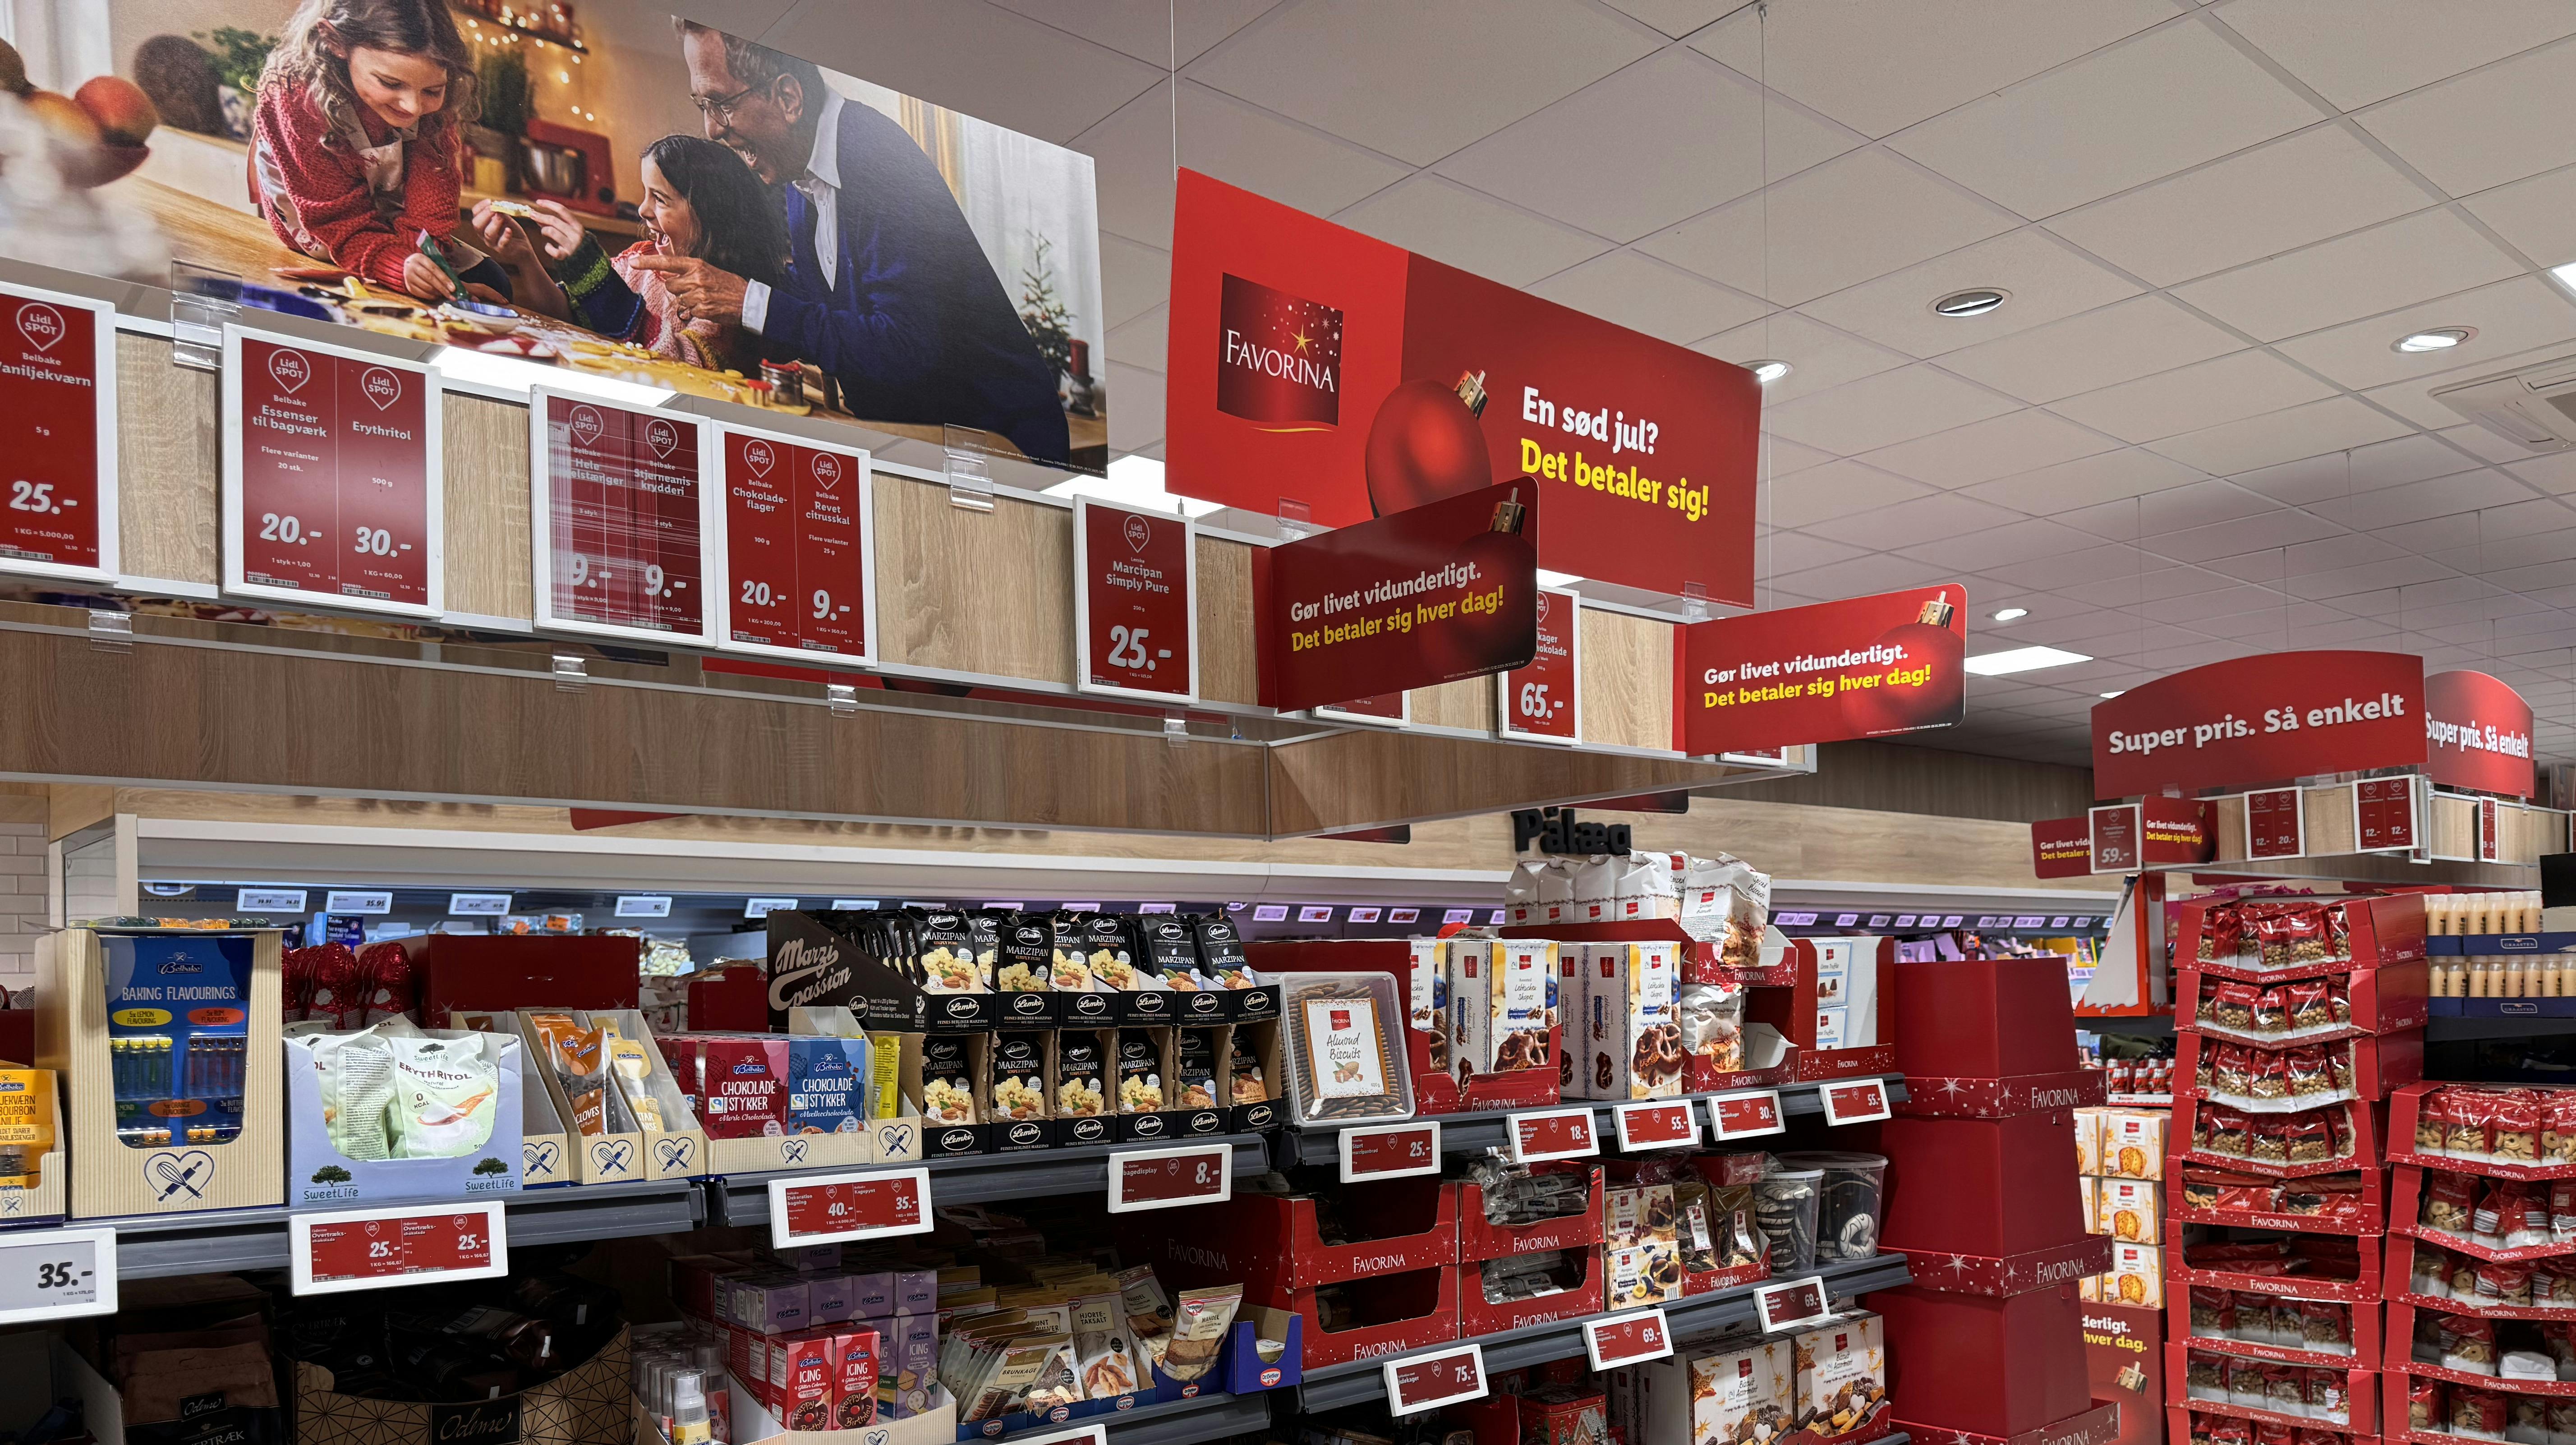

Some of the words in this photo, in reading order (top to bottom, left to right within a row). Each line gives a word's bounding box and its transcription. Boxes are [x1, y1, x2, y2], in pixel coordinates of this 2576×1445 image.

[30, 313, 52, 325] Lidl
[25, 322, 57, 335] SPOT
[22, 352, 61, 365] Belbake
[280, 358, 298, 369] Lidl
[1226, 329, 1334, 393] FAVORINA
[276, 367, 304, 379] SPOT
[372, 376, 390, 387] Lidl
[368, 384, 395, 396] SPOT
[273, 395, 307, 407] Belbake
[262, 405, 318, 423] Essenser
[1523, 386, 1555, 428] En
[1562, 407, 1608, 442] sød
[1612, 411, 1659, 455] jul?
[253, 416, 267, 428] til
[270, 418, 327, 438] bagværk
[353, 421, 411, 440] Erythritol
[261, 446, 281, 456] Flere
[284, 451, 319, 461] varianter
[750, 455, 770, 465] SPOT
[752, 448, 766, 457] Lidl
[575, 458, 600, 471] Hele
[820, 460, 833, 469] Lidl
[634, 469, 691, 486] Stjerneanis
[817, 468, 836, 478] SPOT
[1521, 437, 1568, 482] Det
[1574, 451, 1662, 504] betaler
[1667, 477, 1709, 522] sig!
[372, 477, 386, 485] 500
[641, 480, 685, 496] krydderi
[748, 479, 773, 489] Belbake
[9, 480, 78, 515] 25.-
[733, 487, 787, 504] Chokolade-
[816, 491, 839, 501] Belbake
[747, 499, 775, 513] flager
[814, 501, 841, 514] Revet
[806, 511, 851, 525] citrusskal
[39, 530, 74, 540] 5.000,00
[260, 513, 322, 545] 20.-
[354, 526, 412, 558] 30.-
[809, 534, 823, 542] Flere
[824, 537, 849, 546] varianter
[384, 572, 403, 580] 60,00
[1113, 561, 1163, 579] Marcipan
[644, 564, 687, 598] 9.-
[1106, 573, 1142, 592] Simply
[1145, 580, 1169, 594] Pure
[741, 580, 787, 607] 20.-
[1291, 601, 1320, 622] Gør
[1324, 590, 1360, 615] livet
[1365, 561, 1482, 605] vidunderligt.
[813, 589, 851, 621] 9.-
[1292, 630, 1320, 652] Det
[1324, 617, 1383, 645] betaler
[1387, 607, 1412, 633] sig
[1417, 599, 1457, 625] hver
[1461, 584, 1504, 614] dag!
[1108, 625, 1172, 672] 25.-
[1704, 667, 1736, 685] Gør
[1741, 659, 1780, 681] livet
[1785, 644, 1909, 674] vidunderligt.
[1704, 690, 1735, 709] Det
[1739, 681, 1803, 704] betaler
[1807, 677, 1835, 699] sig
[1840, 673, 1882, 691] hver
[1886, 664, 1932, 688] dag!
[1521, 682, 1564, 719] 65.-
[2109, 725, 2188, 756] Super
[2194, 714, 2256, 749] pris.
[2263, 705, 2300, 734] Så
[2307, 692, 2405, 728] enkelt
[2426, 711, 2458, 748] Super
[2460, 720, 2484, 752] pris.
[2485, 725, 2498, 752] Så
[2499, 730, 2529, 759] enkelt
[2146, 820, 2156, 829] Gør
[2156, 820, 2167, 829] livet
[2146, 831, 2156, 840] Det
[2156, 832, 2173, 842] betaler
[2040, 841, 2055, 850] Gør
[2056, 839, 2074, 848] livet
[2041, 851, 2056, 861] Det
[2057, 849, 2085, 859] betaler
[2101, 847, 2130, 863] 59.-
[922, 932, 966, 942] MARZIPAN
[1089, 935, 1125, 943] MARZIPAN
[775, 937, 839, 978] Marzi
[1006, 945, 1049, 957] MARZIPAN
[1158, 956, 1195, 964] MARZIPAN
[1211, 955, 1245, 964] MARZIPAN
[1734, 970, 1765, 981] FAVORINA
[122, 987, 162, 1001] BAKING
[166, 986, 236, 1000] FLAVOURINGS
[792, 966, 851, 1007] passion
[1327, 1032, 1361, 1047] Almond
[1329, 1048, 1361, 1060] Biscuits
[399, 1062, 472, 1081] ERYTHRITOL
[998, 1060, 1039, 1070] MARZIPAN
[1062, 1062, 1098, 1072] MARZIPAN
[721, 1080, 776, 1096] CHOKOLADE
[802, 1077, 853, 1092] CHOKOLADE
[414, 1100, 430, 1109] KCAL
[729, 1096, 768, 1111] STYKKER
[810, 1093, 846, 1108] STYKKER
[1472, 1098, 1516, 1111] FAVORINA
[2031, 1087, 2079, 1109] FAVORINA
[575, 1106, 600, 1123] CLOVES
[1570, 1125, 1587, 1140] 18.-
[1409, 1141, 1431, 1157] 25.-
[1123, 1168, 1157, 1177] bagedisplay
[1195, 1162, 1219, 1184] 8.-
[2488, 1167, 2526, 1180] FAVORINA
[465, 1178, 515, 1191] SweetLife
[304, 1187, 359, 1200] SweetLife
[828, 1202, 854, 1216] 40.-
[896, 1196, 917, 1210] 35.-
[2251, 1215, 2300, 1229] FAVORINA
[369, 1241, 401, 1258] 25.-
[458, 1234, 488, 1251] 25.-
[1513, 1235, 1559, 1252] FAVORINA
[1168, 1238, 1228, 1271] FAVORINA
[1353, 1254, 1405, 1273] FAVORINA
[37, 1261, 93, 1290] 35.-
[2037, 1259, 2084, 1284] FAVORINA
[2250, 1279, 2298, 1294] FAVORINA
[1080, 1311, 1105, 1319] HJORTE-
[1081, 1317, 1107, 1325] TAKSALT
[1202, 1314, 1219, 1323] MANDEL
[2084, 1330, 2112, 1346] hver
[2116, 1335, 2147, 1353] dag.
[909, 1343, 929, 1356] ICING
[1354, 1339, 1407, 1360] FAVORINA
[2254, 1348, 2286, 1359] FAVORINA
[799, 1369, 821, 1383] ICING
[847, 1362, 868, 1376] ICING
[1002, 1367, 1037, 1376] BRUNKAGE
[1455, 1365, 1475, 1383] 75.-
[845, 1405, 874, 1427] Birthday
[440, 1410, 512, 1440] Odense
